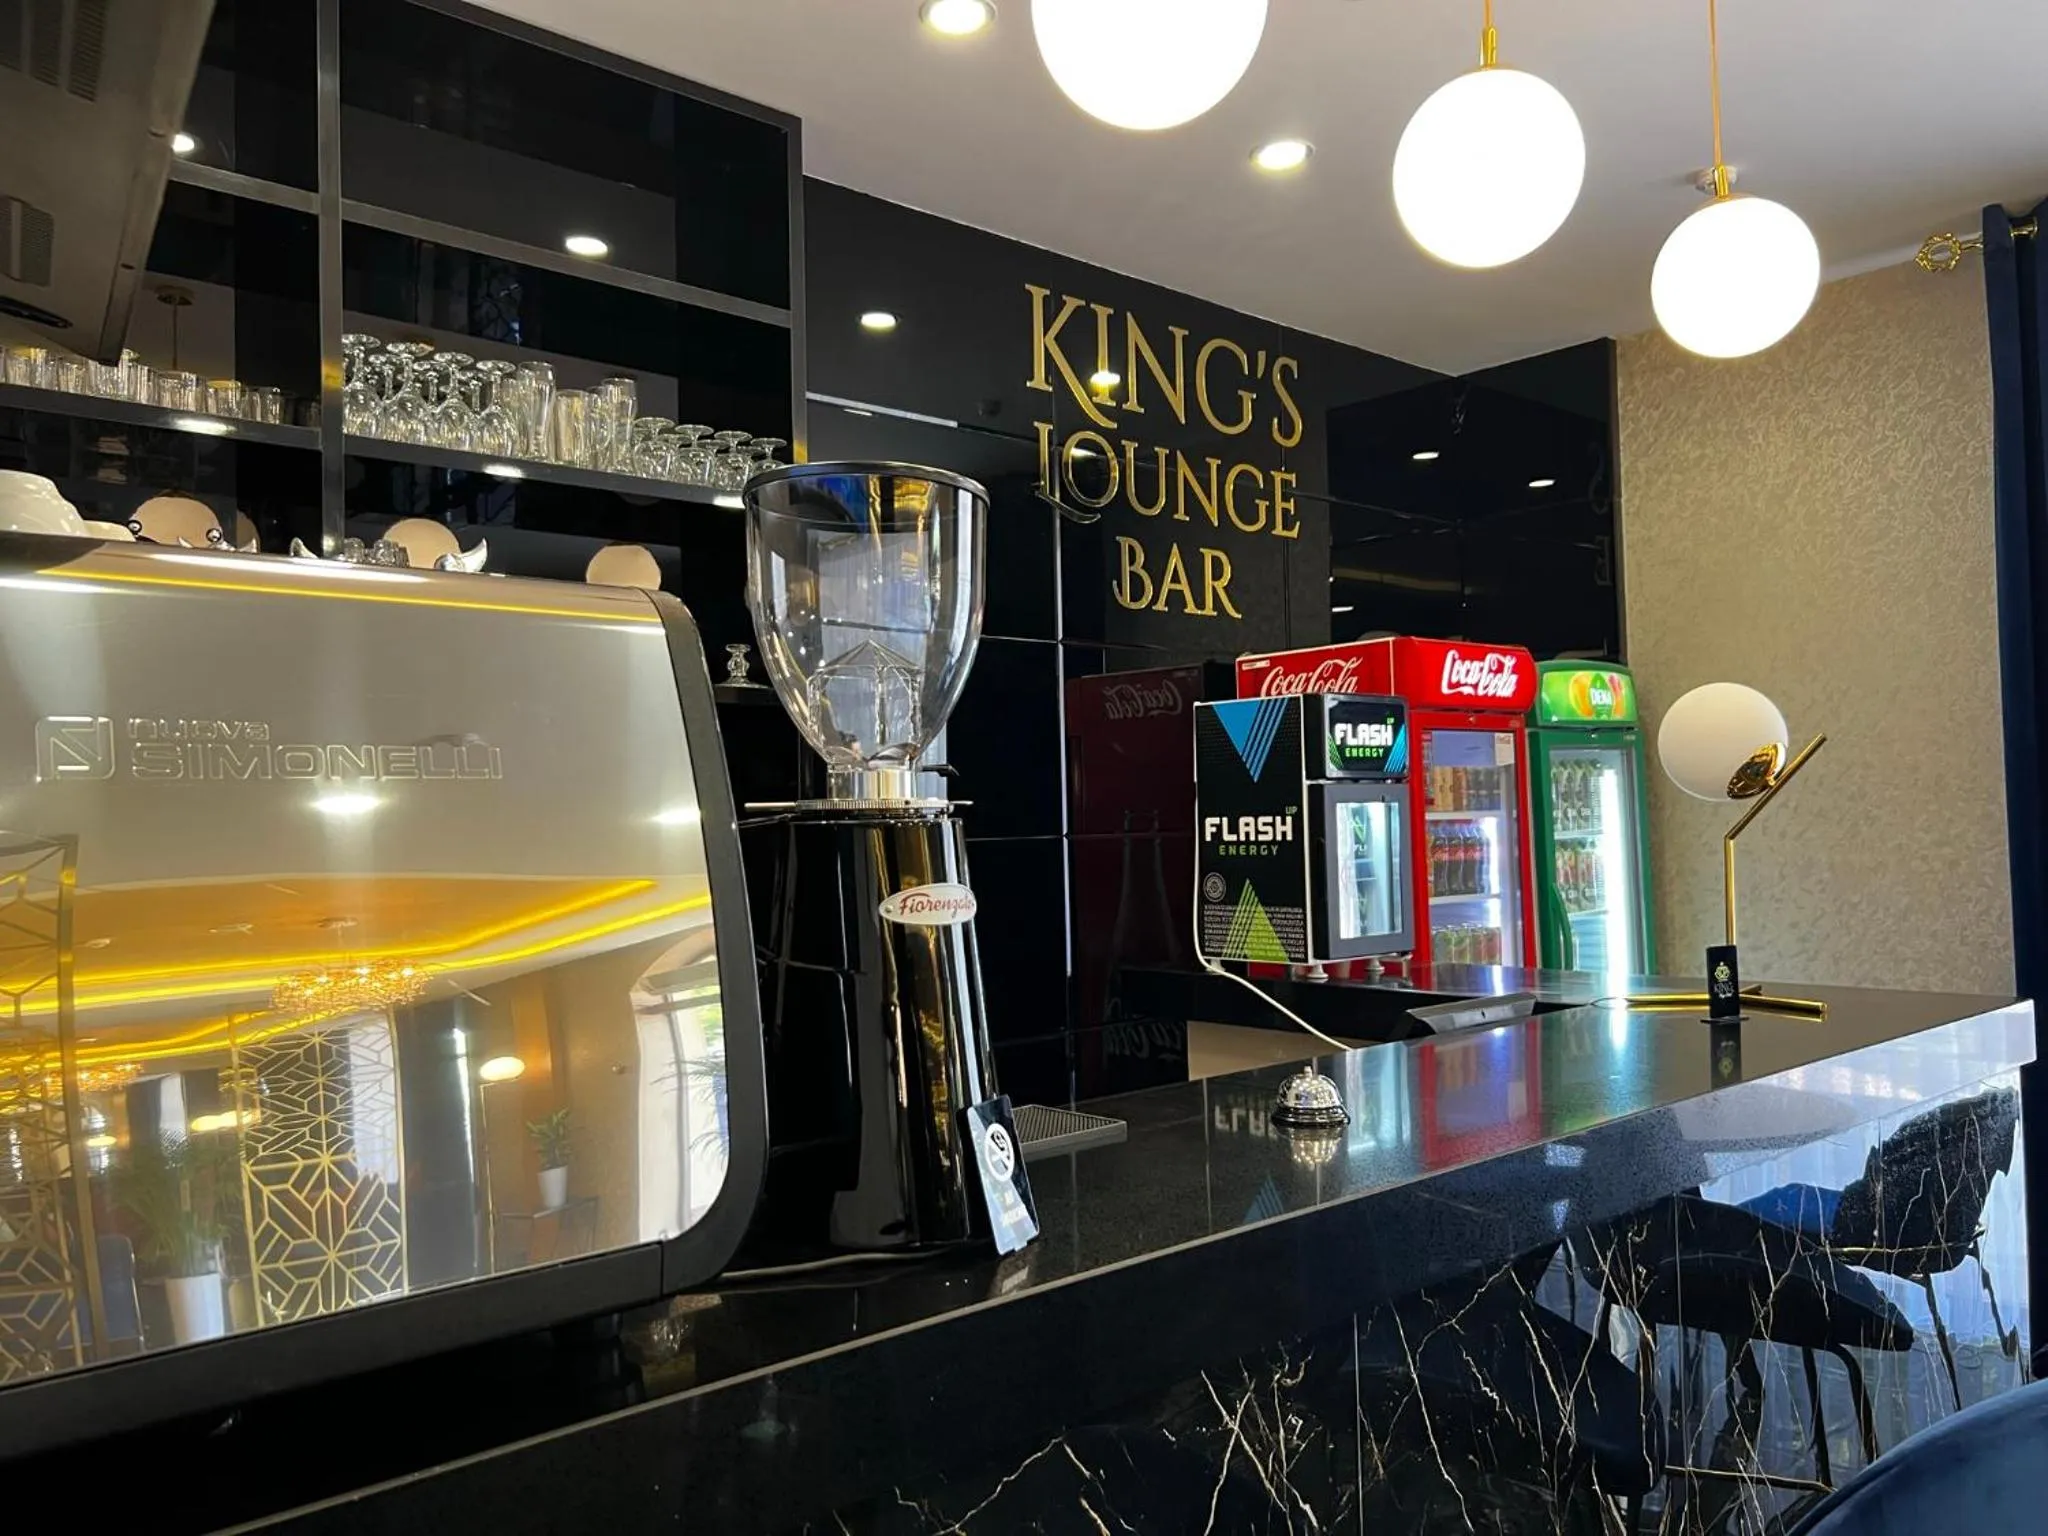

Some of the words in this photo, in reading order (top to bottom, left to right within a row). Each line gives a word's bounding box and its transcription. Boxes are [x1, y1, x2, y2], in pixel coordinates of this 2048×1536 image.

[1025, 283, 1303, 448] KING'S
[1032, 421, 1300, 538] LOUNGE
[1113, 535, 1242, 619] BAR
[1441, 649, 1519, 698] Coca-Cola
[128, 718, 270, 740] nuova
[1334, 722, 1394, 746] FLASH
[131, 742, 503, 781] SIMONELLI
[1345, 747, 1384, 757] ENERGY
[1205, 816, 1293, 841] FLASH
[1219, 845, 1279, 855] ENERGY
